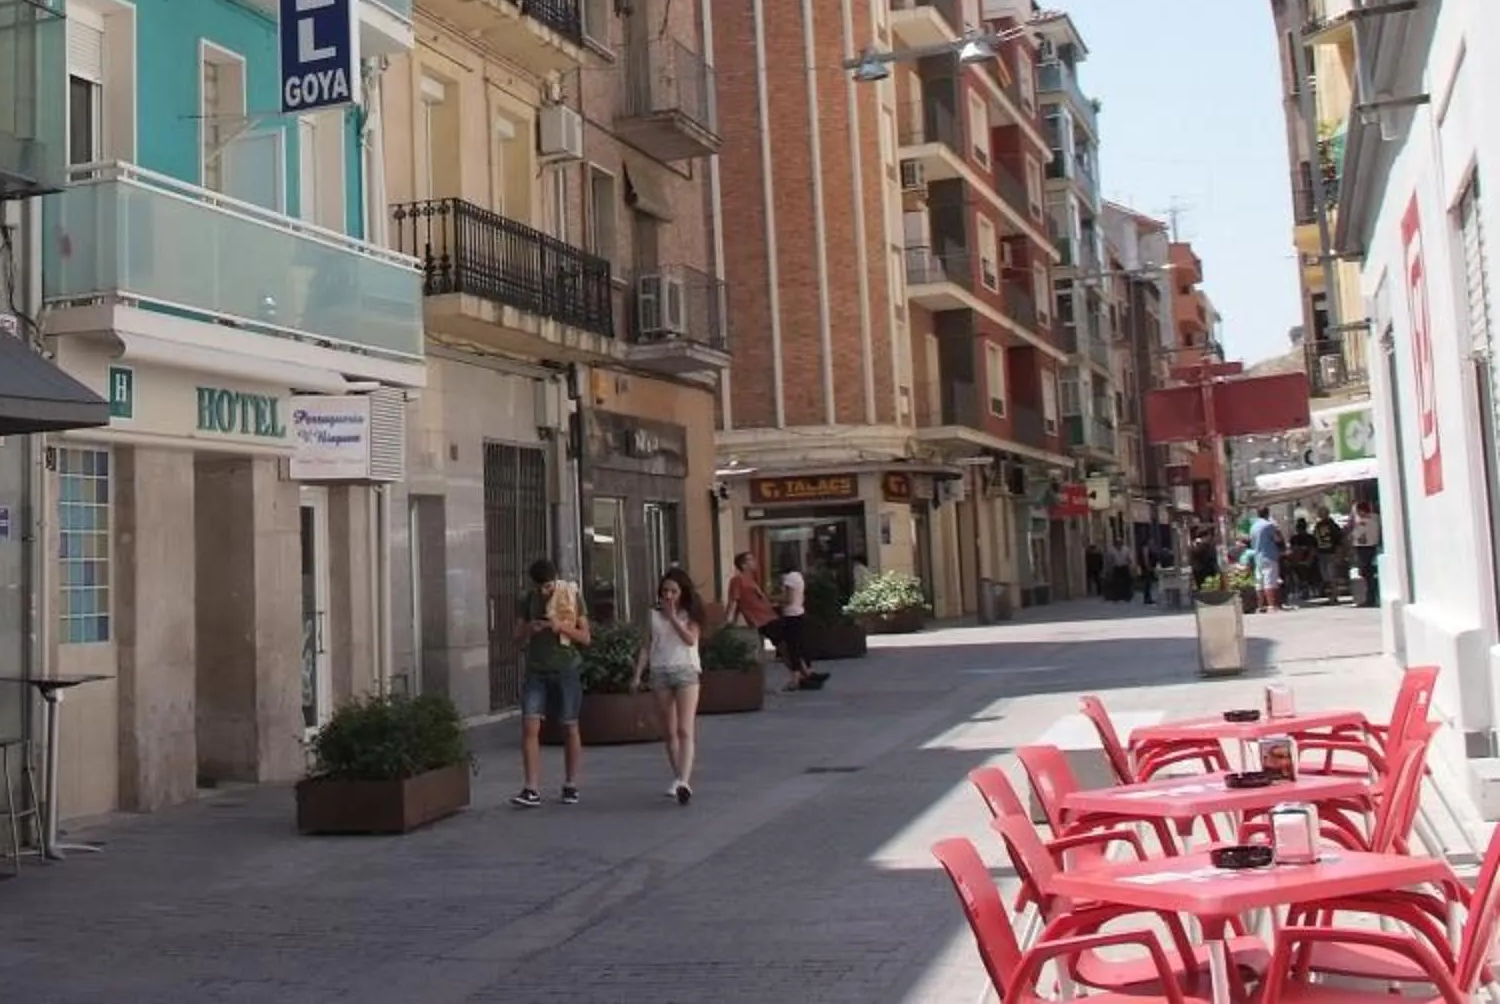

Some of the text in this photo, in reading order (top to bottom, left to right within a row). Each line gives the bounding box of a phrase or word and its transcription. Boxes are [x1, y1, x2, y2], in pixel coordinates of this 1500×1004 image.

[284, 67, 349, 108] GOYA
[114, 372, 128, 403] H
[196, 386, 287, 439] HOTEL
